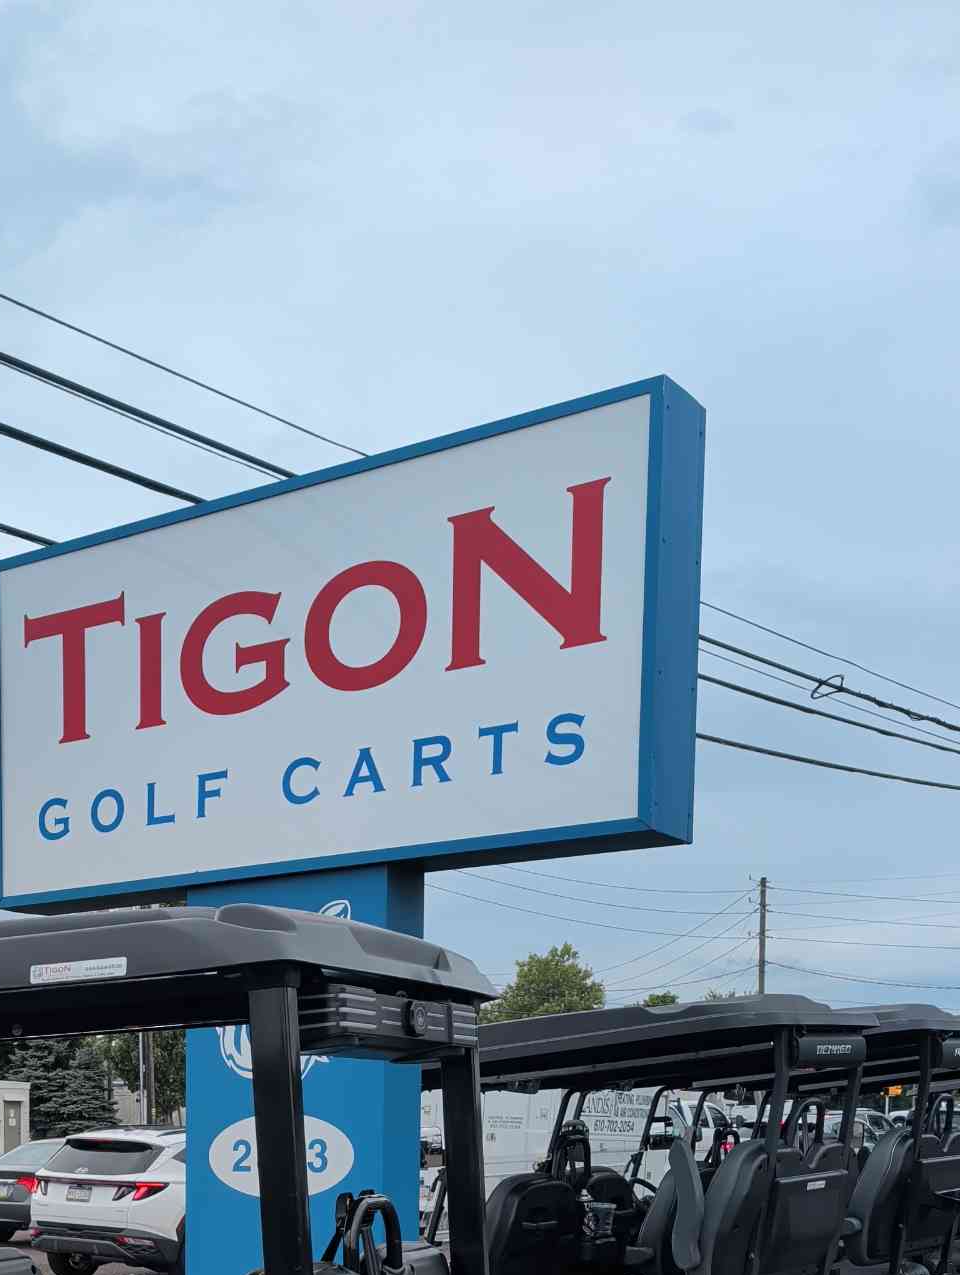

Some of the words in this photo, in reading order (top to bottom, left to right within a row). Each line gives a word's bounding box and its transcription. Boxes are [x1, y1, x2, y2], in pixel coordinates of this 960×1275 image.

[24, 476, 612, 744] TIGON
[37, 769, 229, 841] GOLF
[281, 712, 587, 805] CARTS
